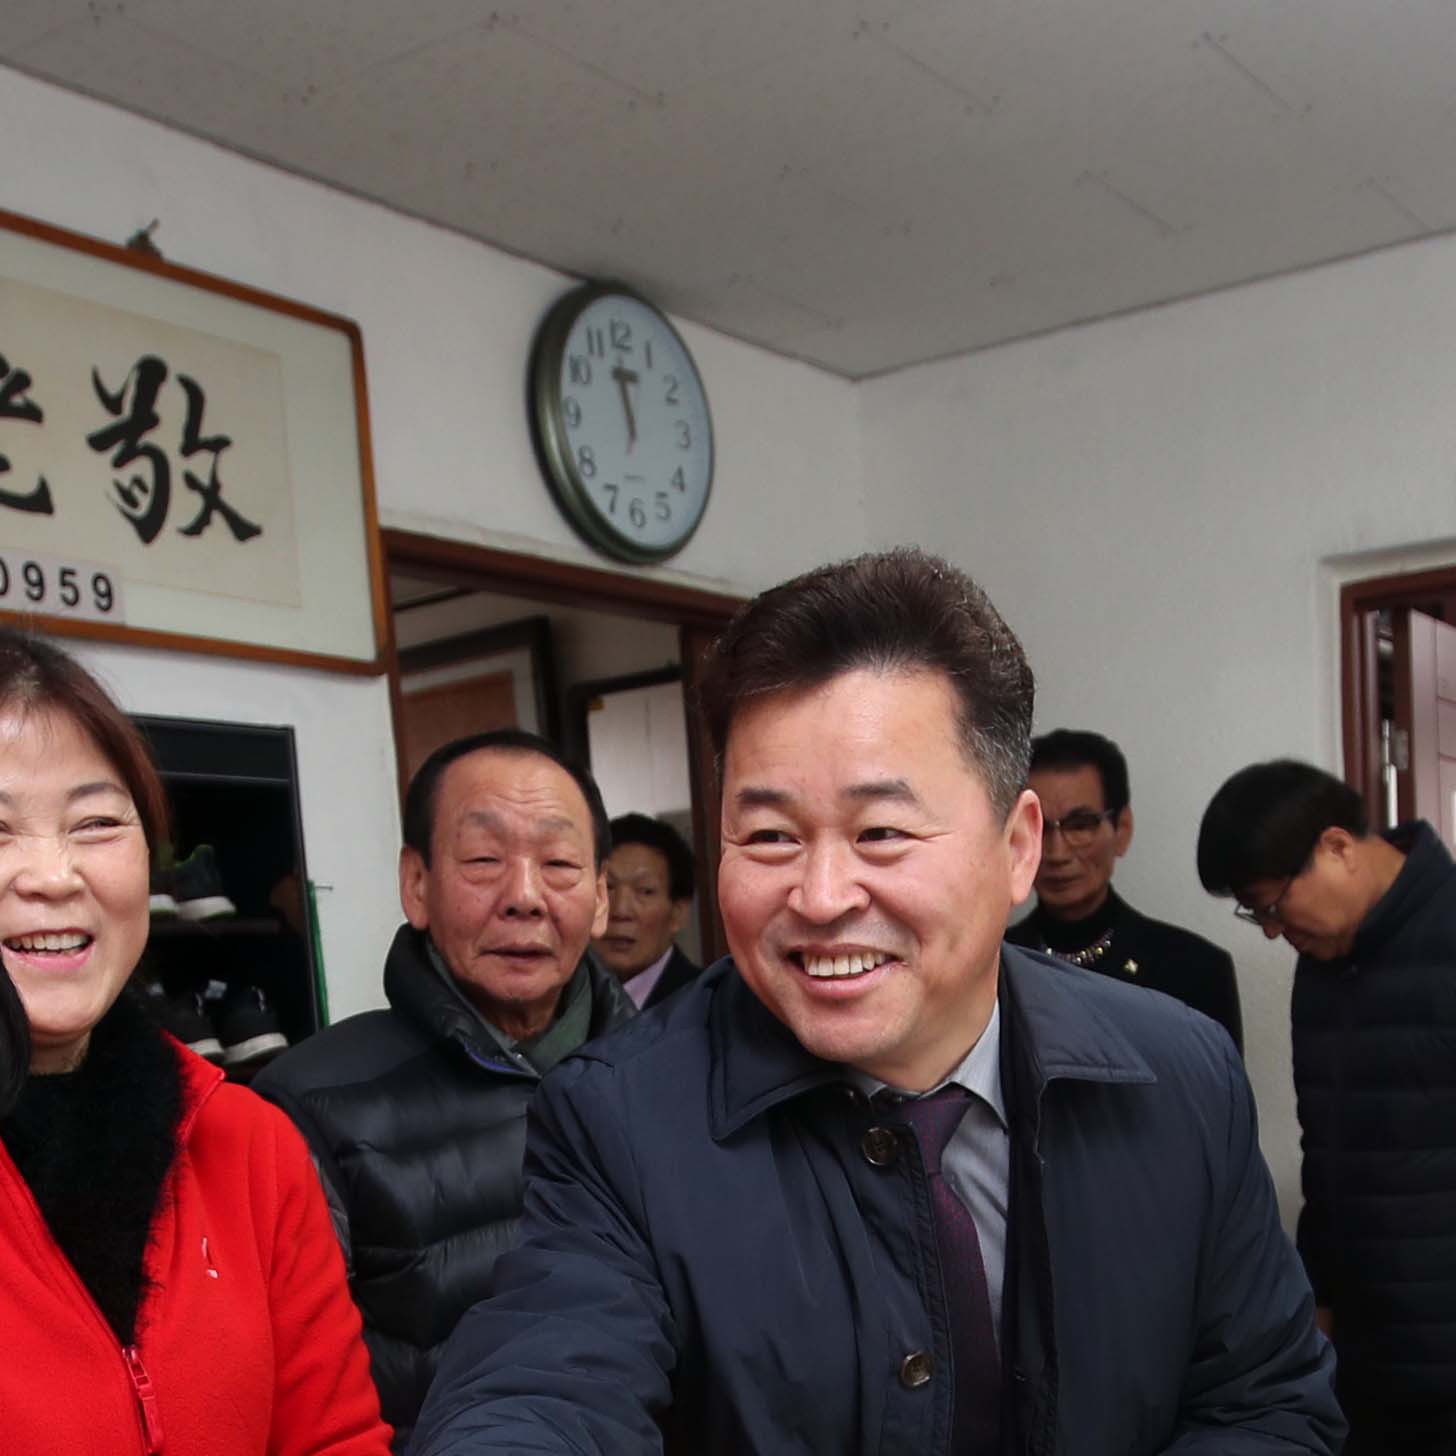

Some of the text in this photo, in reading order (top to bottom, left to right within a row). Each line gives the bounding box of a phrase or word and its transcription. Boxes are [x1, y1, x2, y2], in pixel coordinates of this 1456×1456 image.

[586, 326, 605, 359] 11
[610, 318, 632, 352] 12
[568, 353, 592, 386] 10
[645, 340, 653, 370] 1
[664, 373, 680, 406] 2
[563, 395, 582, 429] 9
[674, 418, 691, 450] 3
[578, 444, 596, 478] 8
[671, 466, 686, 493] 4
[603, 482, 620, 514] 7
[629, 497, 646, 529] 6
[655, 491, 672, 522] 5
